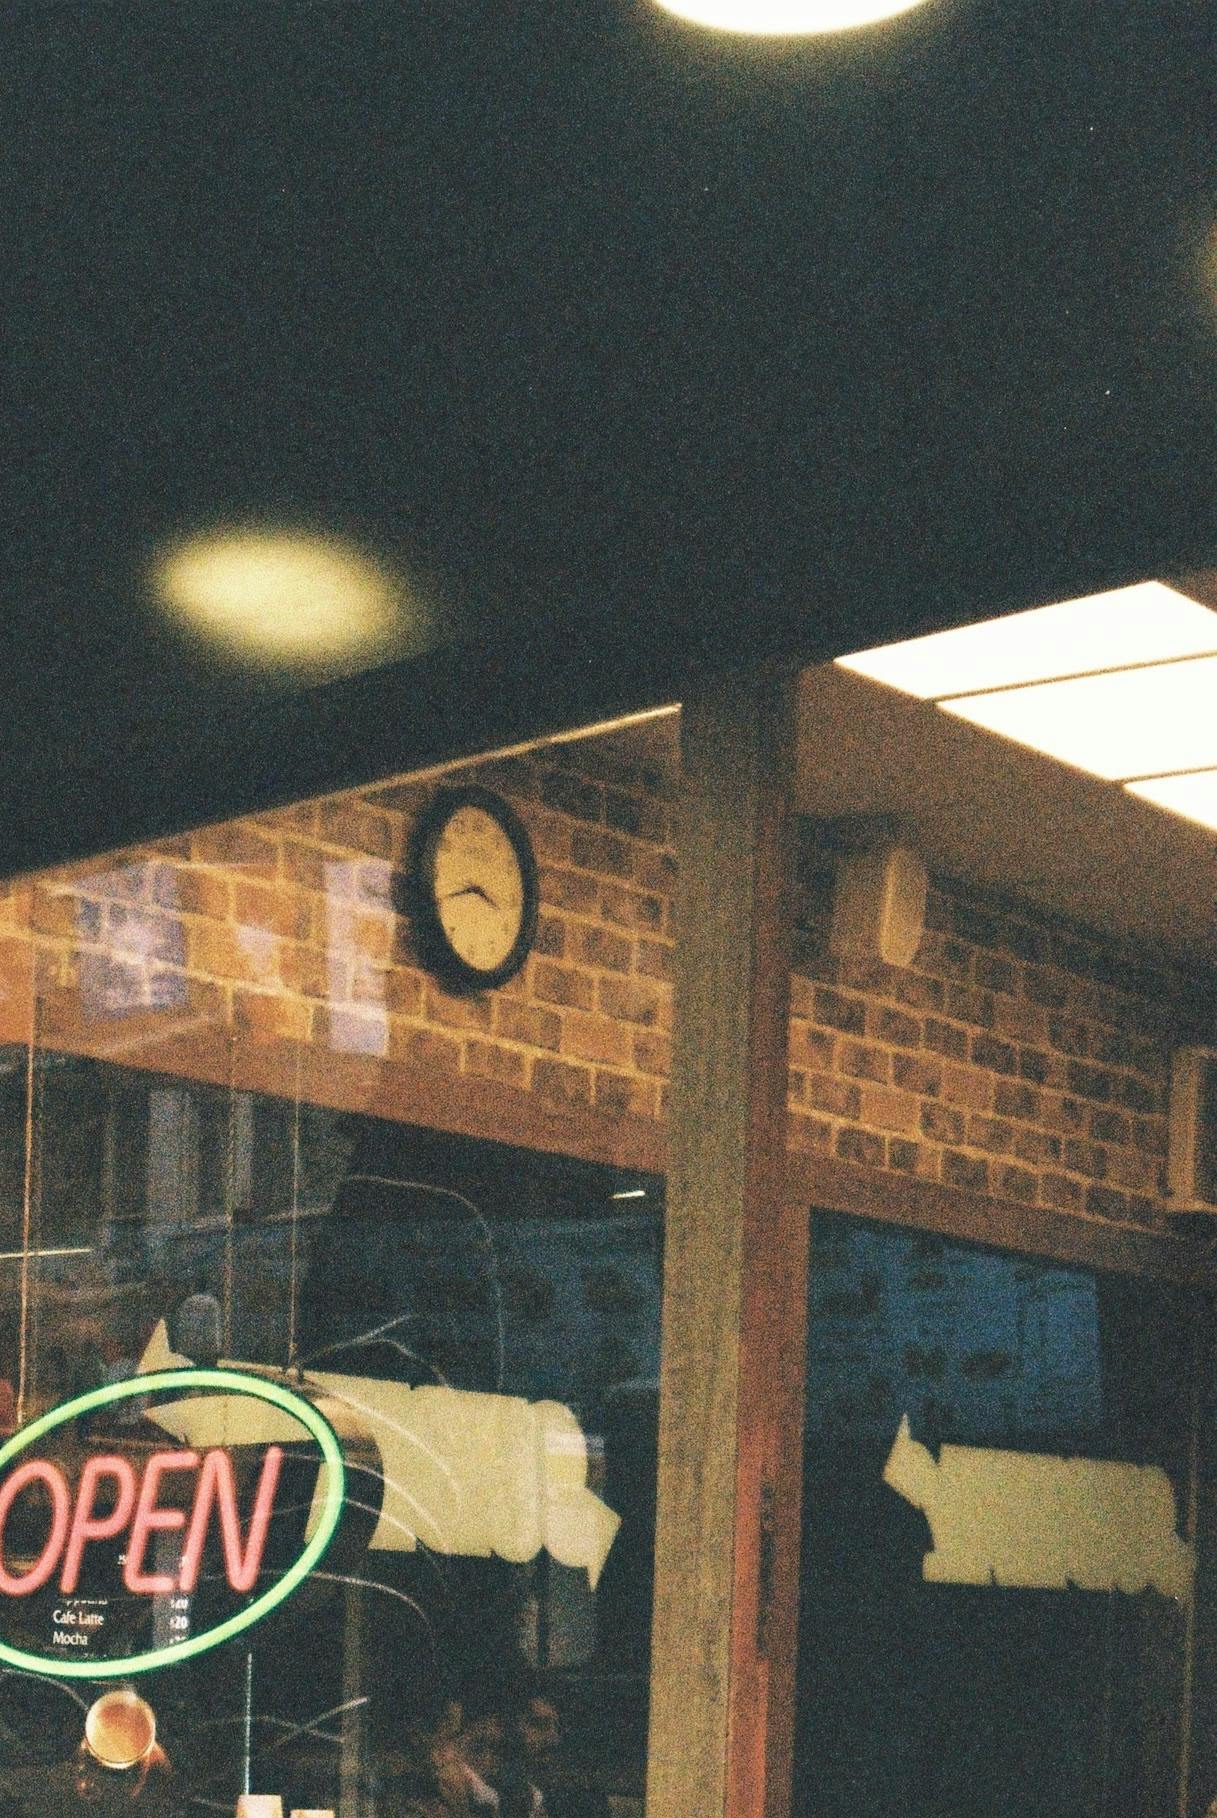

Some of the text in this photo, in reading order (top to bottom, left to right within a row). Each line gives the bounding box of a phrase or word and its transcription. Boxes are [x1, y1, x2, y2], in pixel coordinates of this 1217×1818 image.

[53, 1609, 104, 1625] Cafe Latte
[52, 1630, 88, 1646] Mocha
